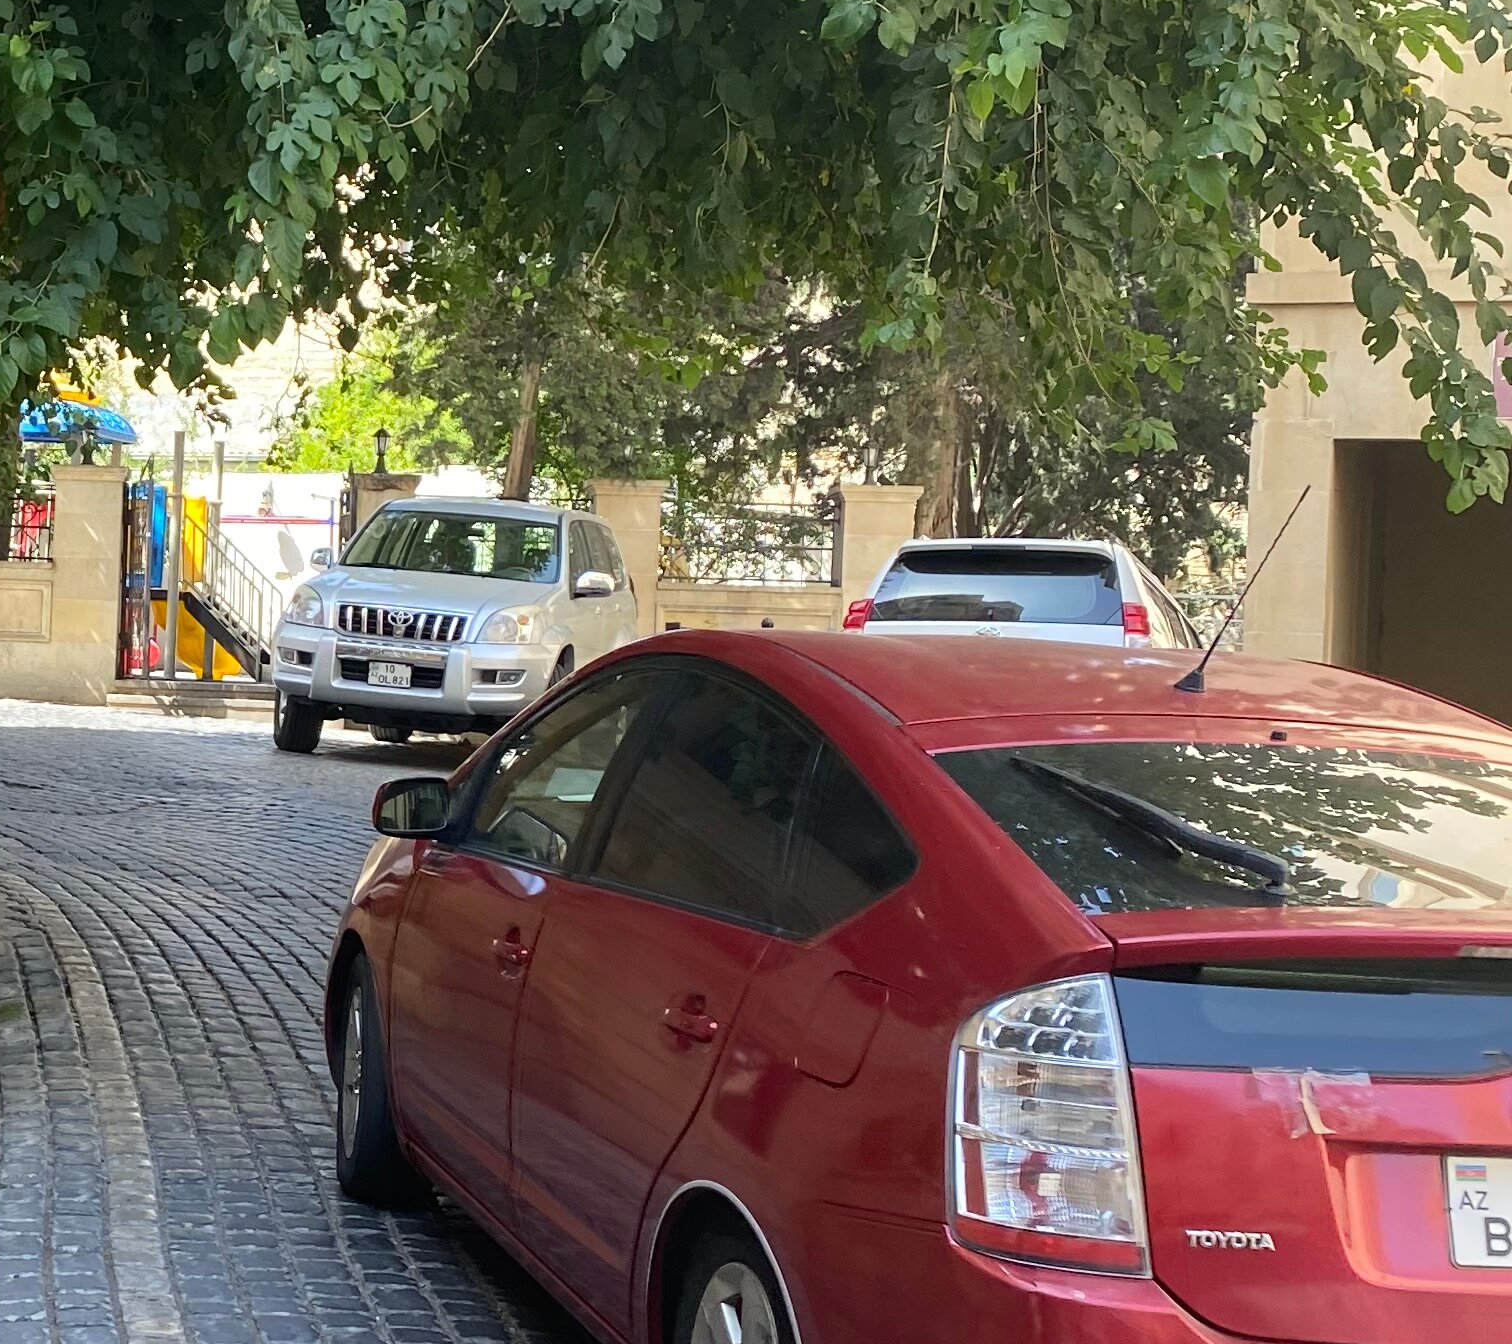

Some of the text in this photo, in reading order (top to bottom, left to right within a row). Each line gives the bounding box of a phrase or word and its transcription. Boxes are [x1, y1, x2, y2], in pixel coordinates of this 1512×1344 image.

[385, 664, 396, 674] 10
[1459, 1190, 1489, 1211] AZ
[1185, 1229, 1276, 1252] TOYOTA
